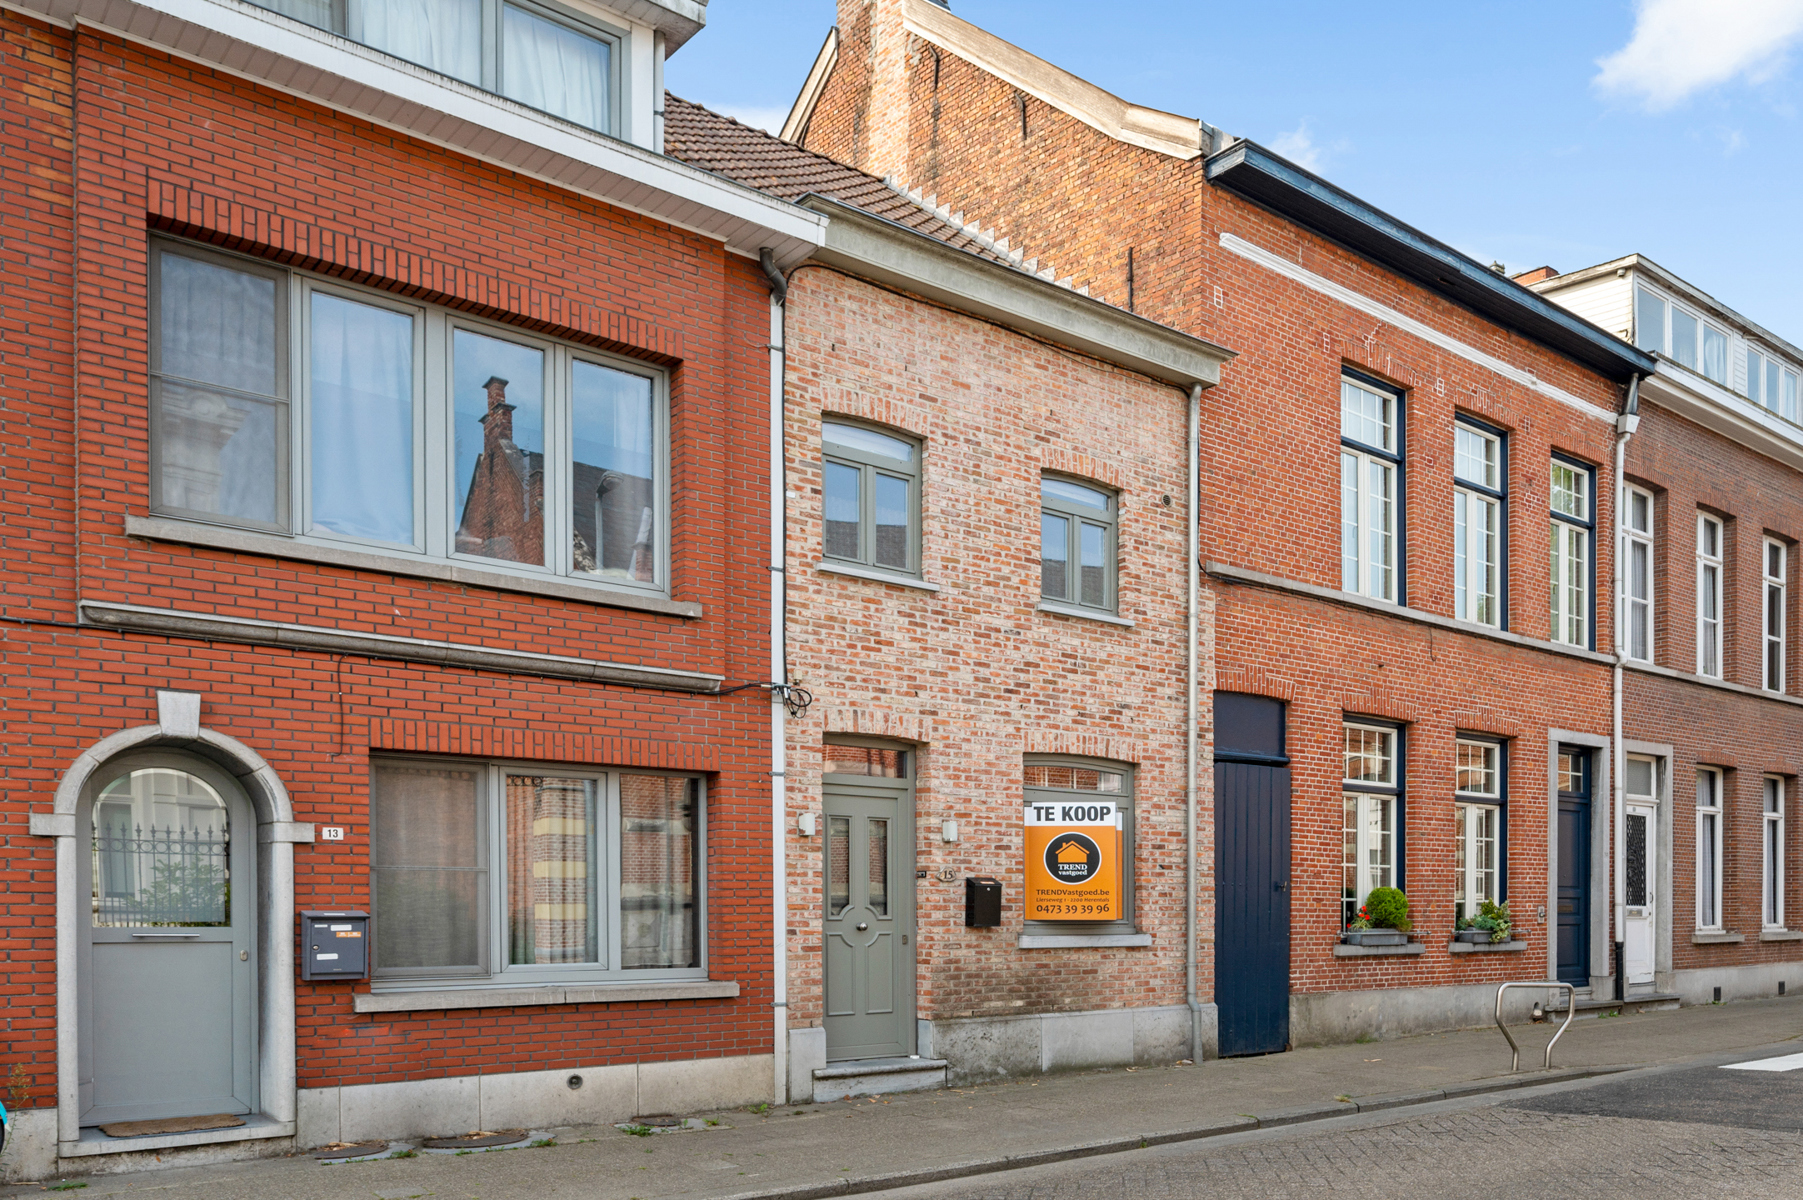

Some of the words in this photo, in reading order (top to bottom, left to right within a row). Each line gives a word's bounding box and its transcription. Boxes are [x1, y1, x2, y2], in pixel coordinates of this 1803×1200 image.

[1033, 806, 1055, 821] TE
[1061, 806, 1111, 821] KOOP
[327, 829, 338, 838] 13
[944, 870, 953, 879] 15
[1036, 889, 1109, 897] TRENDVastgoed.be
[1036, 904, 1062, 914] 0473
[1065, 904, 1078, 914] 39
[1080, 904, 1093, 914] 39
[1096, 904, 1110, 914] 96
